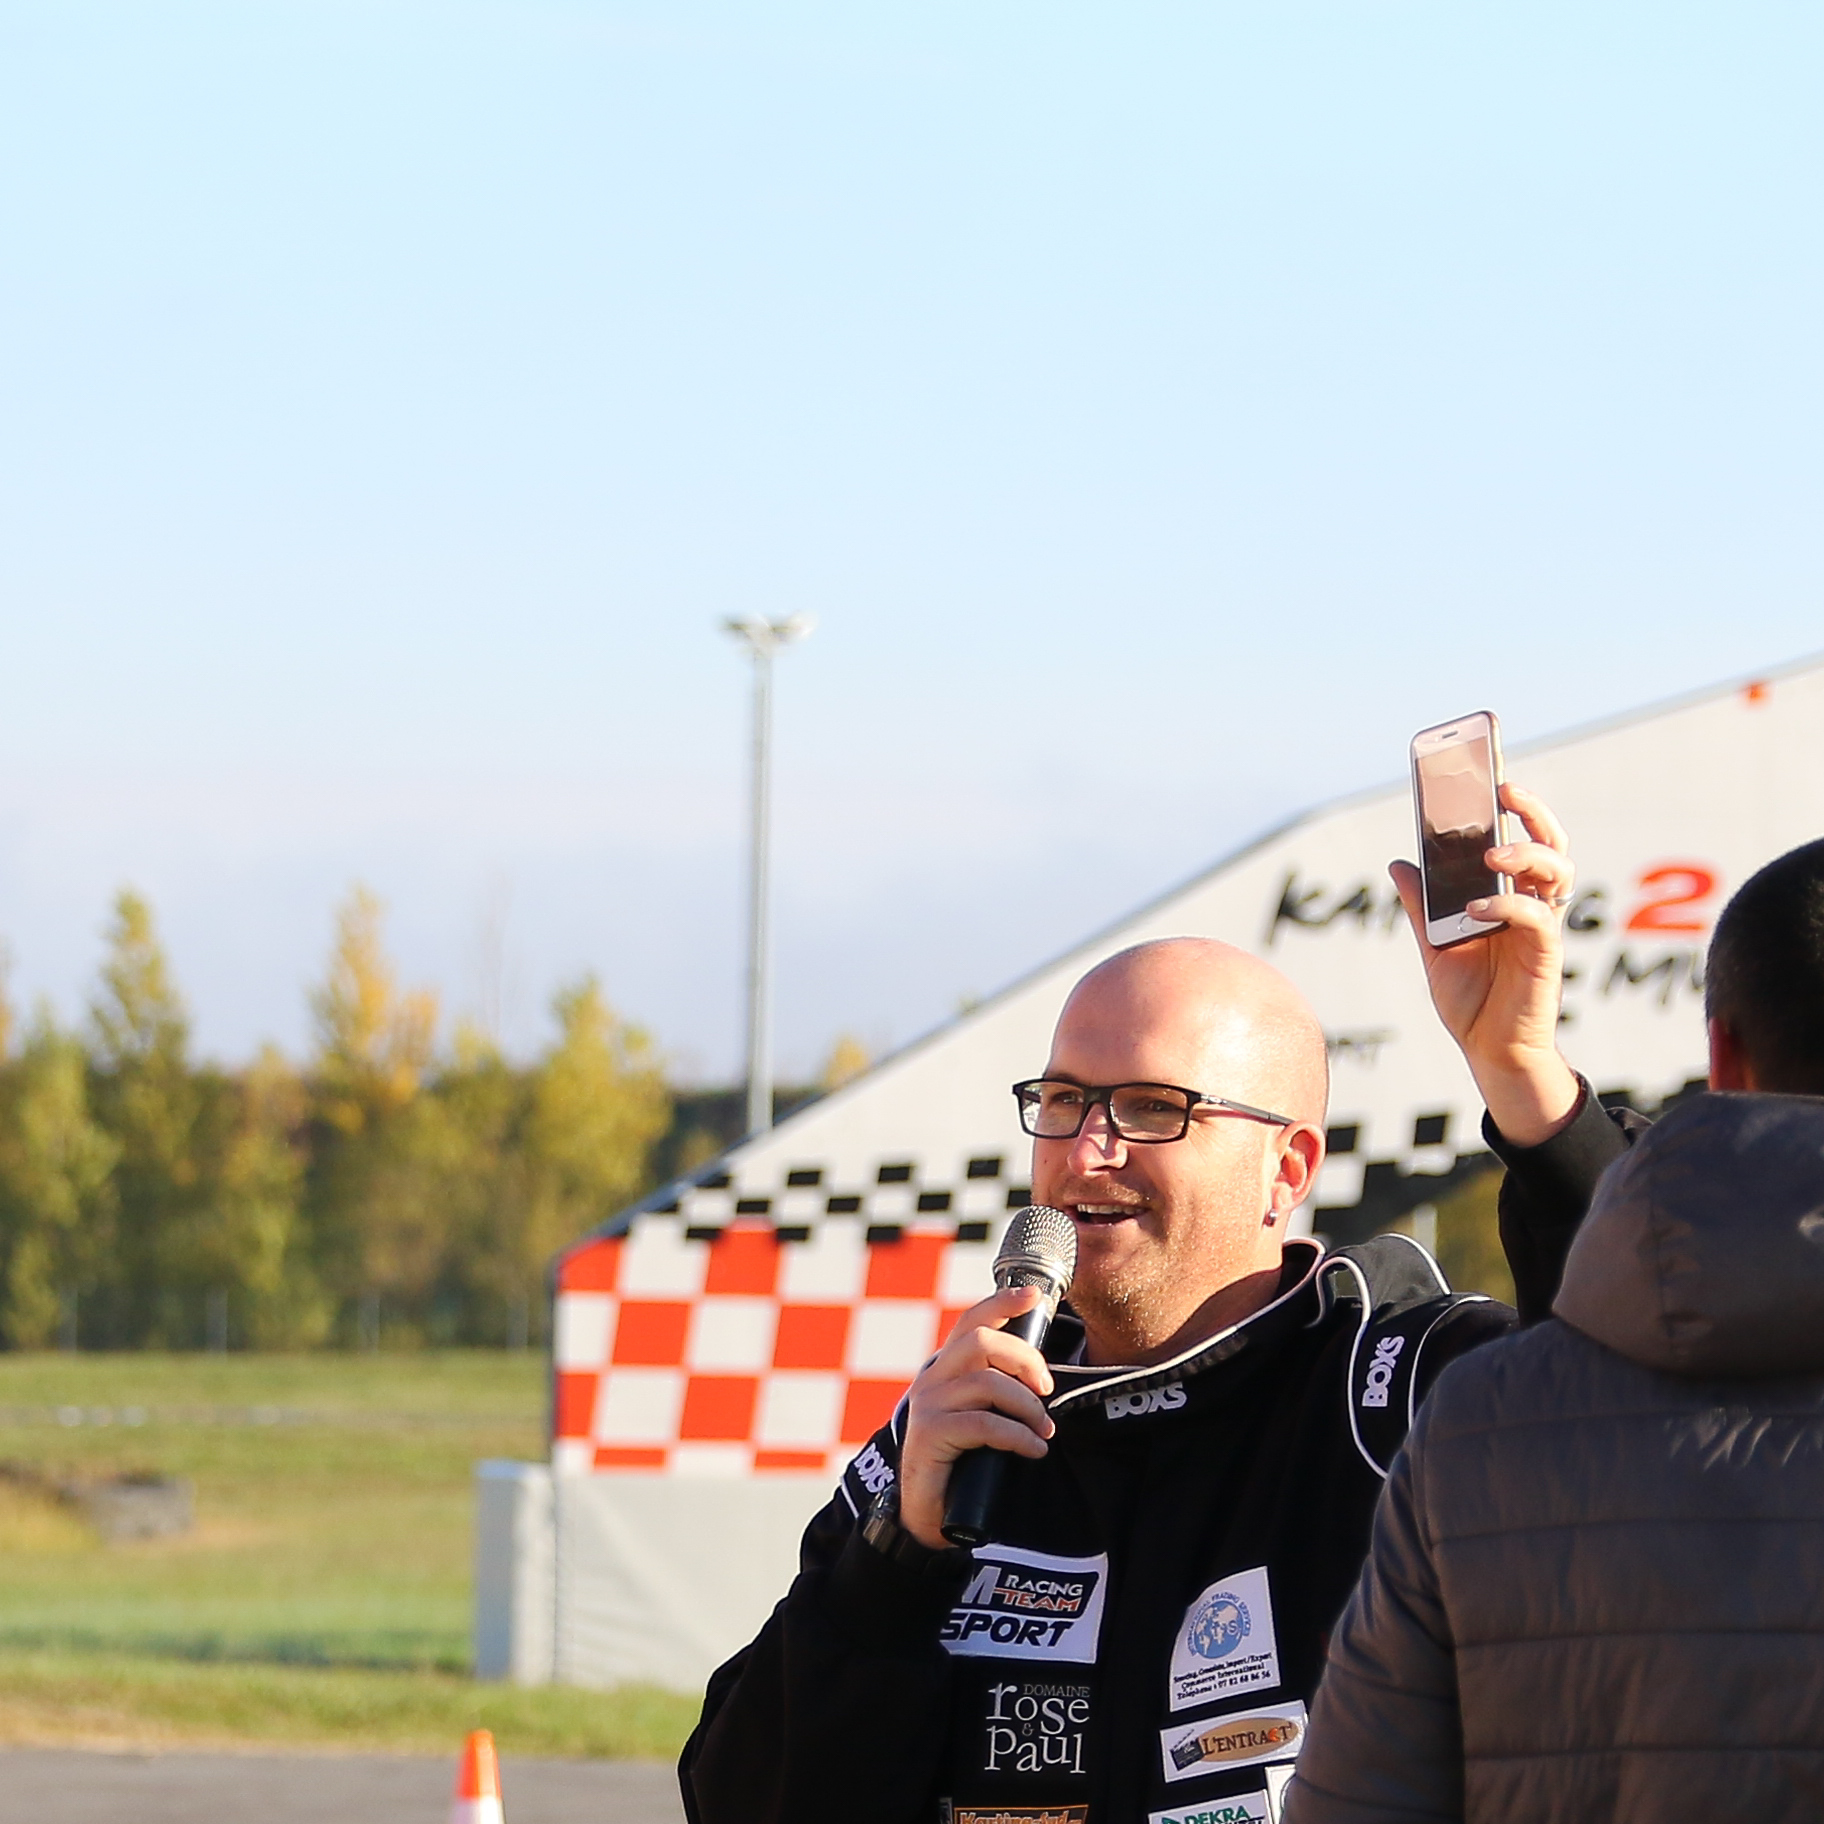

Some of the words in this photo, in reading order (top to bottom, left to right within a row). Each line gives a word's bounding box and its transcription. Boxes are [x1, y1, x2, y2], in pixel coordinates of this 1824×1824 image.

[1627, 867, 1715, 932] 2
[1004, 1575, 1083, 1596] RACING
[994, 1587, 1082, 1611] TEAM
[939, 1612, 1074, 1646] SPORT
[1023, 1684, 1090, 1698] DOMAINE
[986, 1683, 1090, 1735] rose
[1022, 1723, 1034, 1736] &
